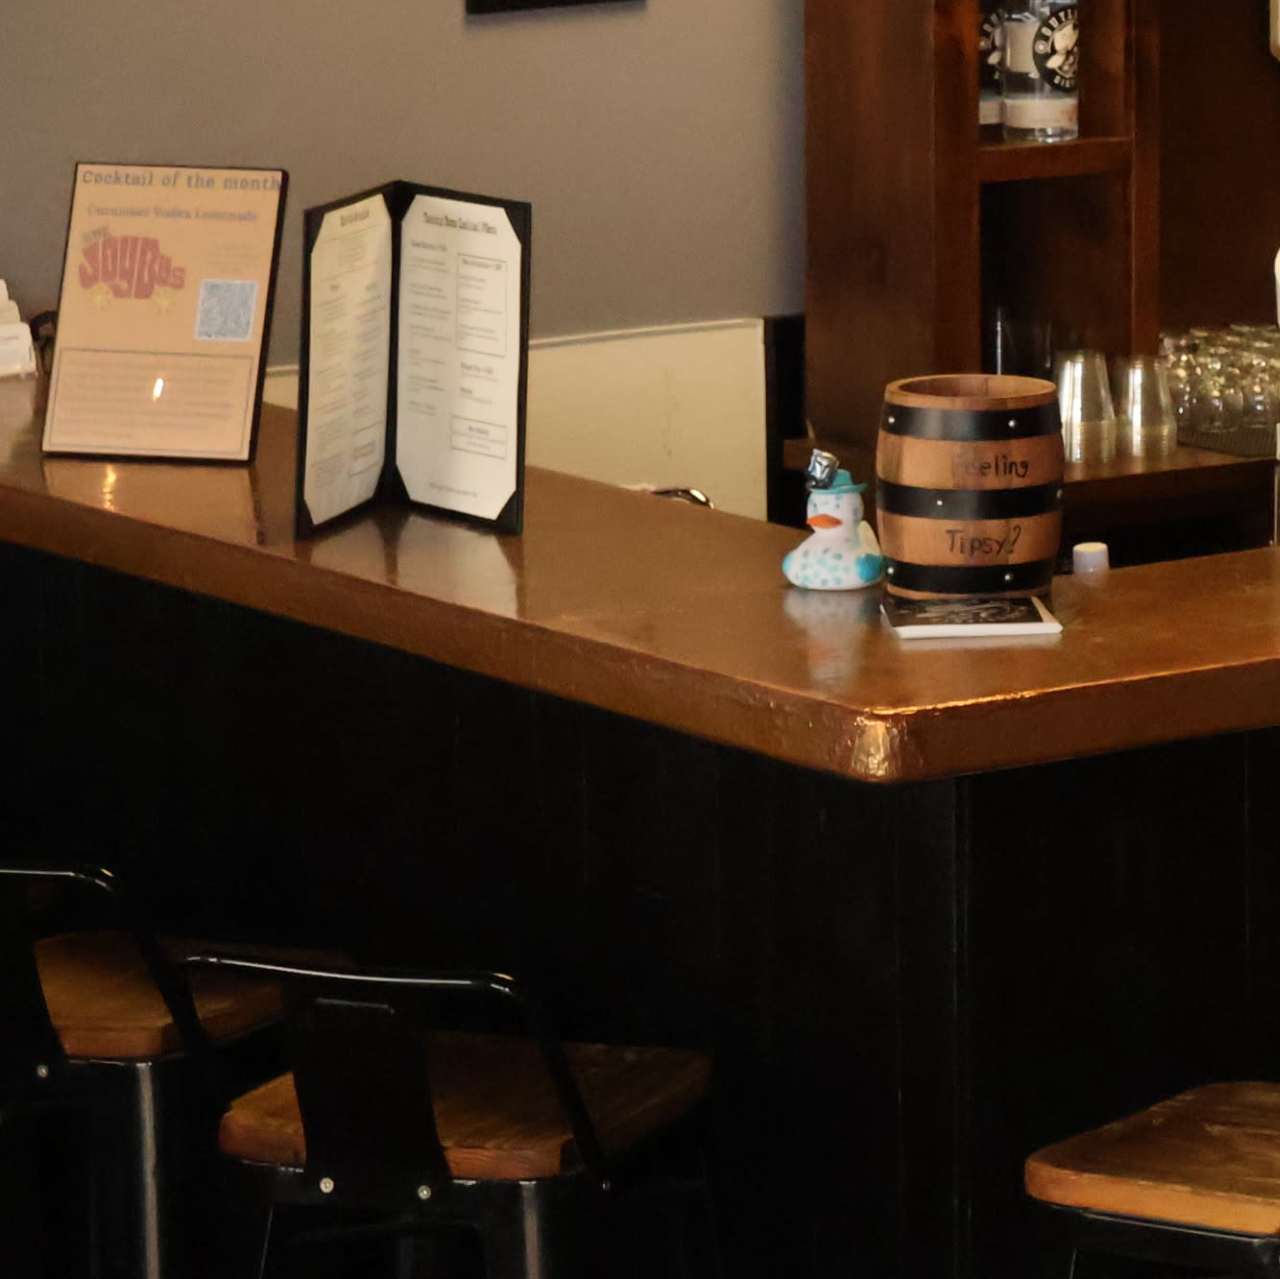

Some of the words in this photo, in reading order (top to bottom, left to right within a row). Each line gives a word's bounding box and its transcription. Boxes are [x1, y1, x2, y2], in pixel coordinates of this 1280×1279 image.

[83, 170, 154, 186] Cocktail
[161, 172, 179, 186] of
[186, 173, 215, 189] the
[223, 175, 281, 191] month
[964, 454, 1030, 478] eling
